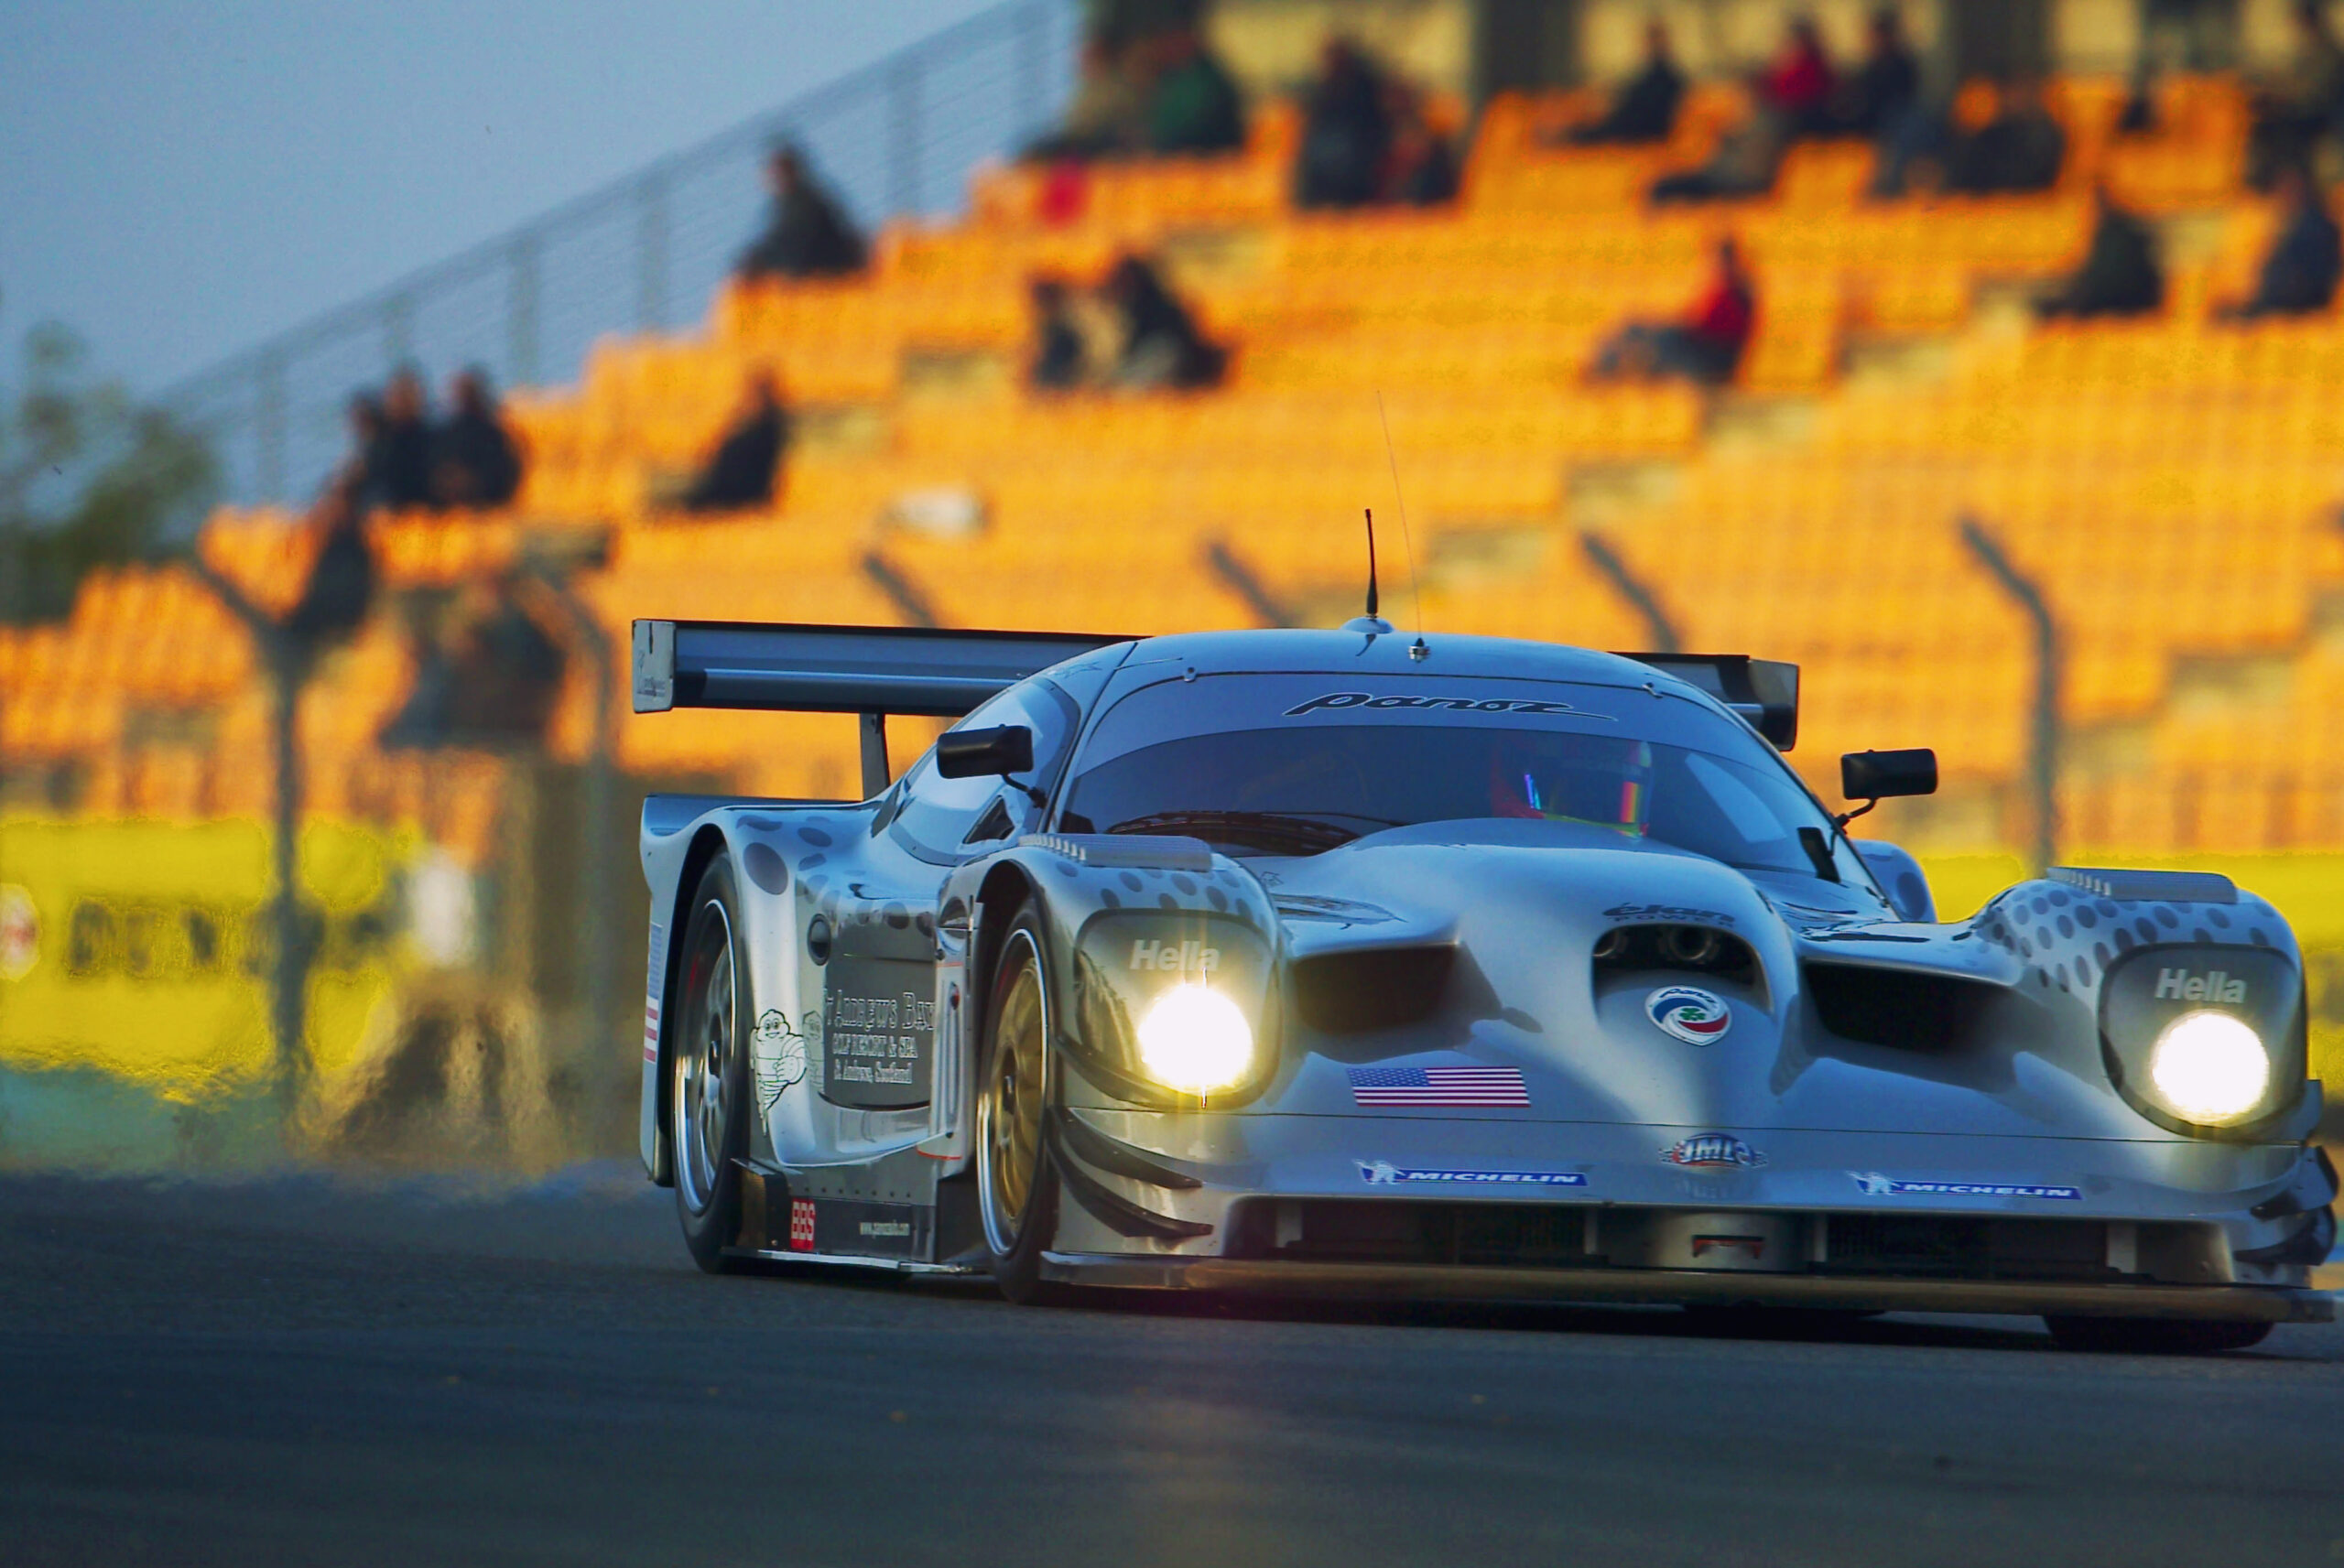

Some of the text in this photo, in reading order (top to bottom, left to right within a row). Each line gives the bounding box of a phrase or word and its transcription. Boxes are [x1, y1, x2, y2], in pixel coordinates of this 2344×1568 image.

[1129, 939, 1220, 971] Hella
[2154, 968, 2247, 1003] Hella
[1406, 1172, 1579, 1183] MICHELIN
[1903, 1183, 2072, 1197] MICHELIN
[791, 1201, 815, 1241] BBS
